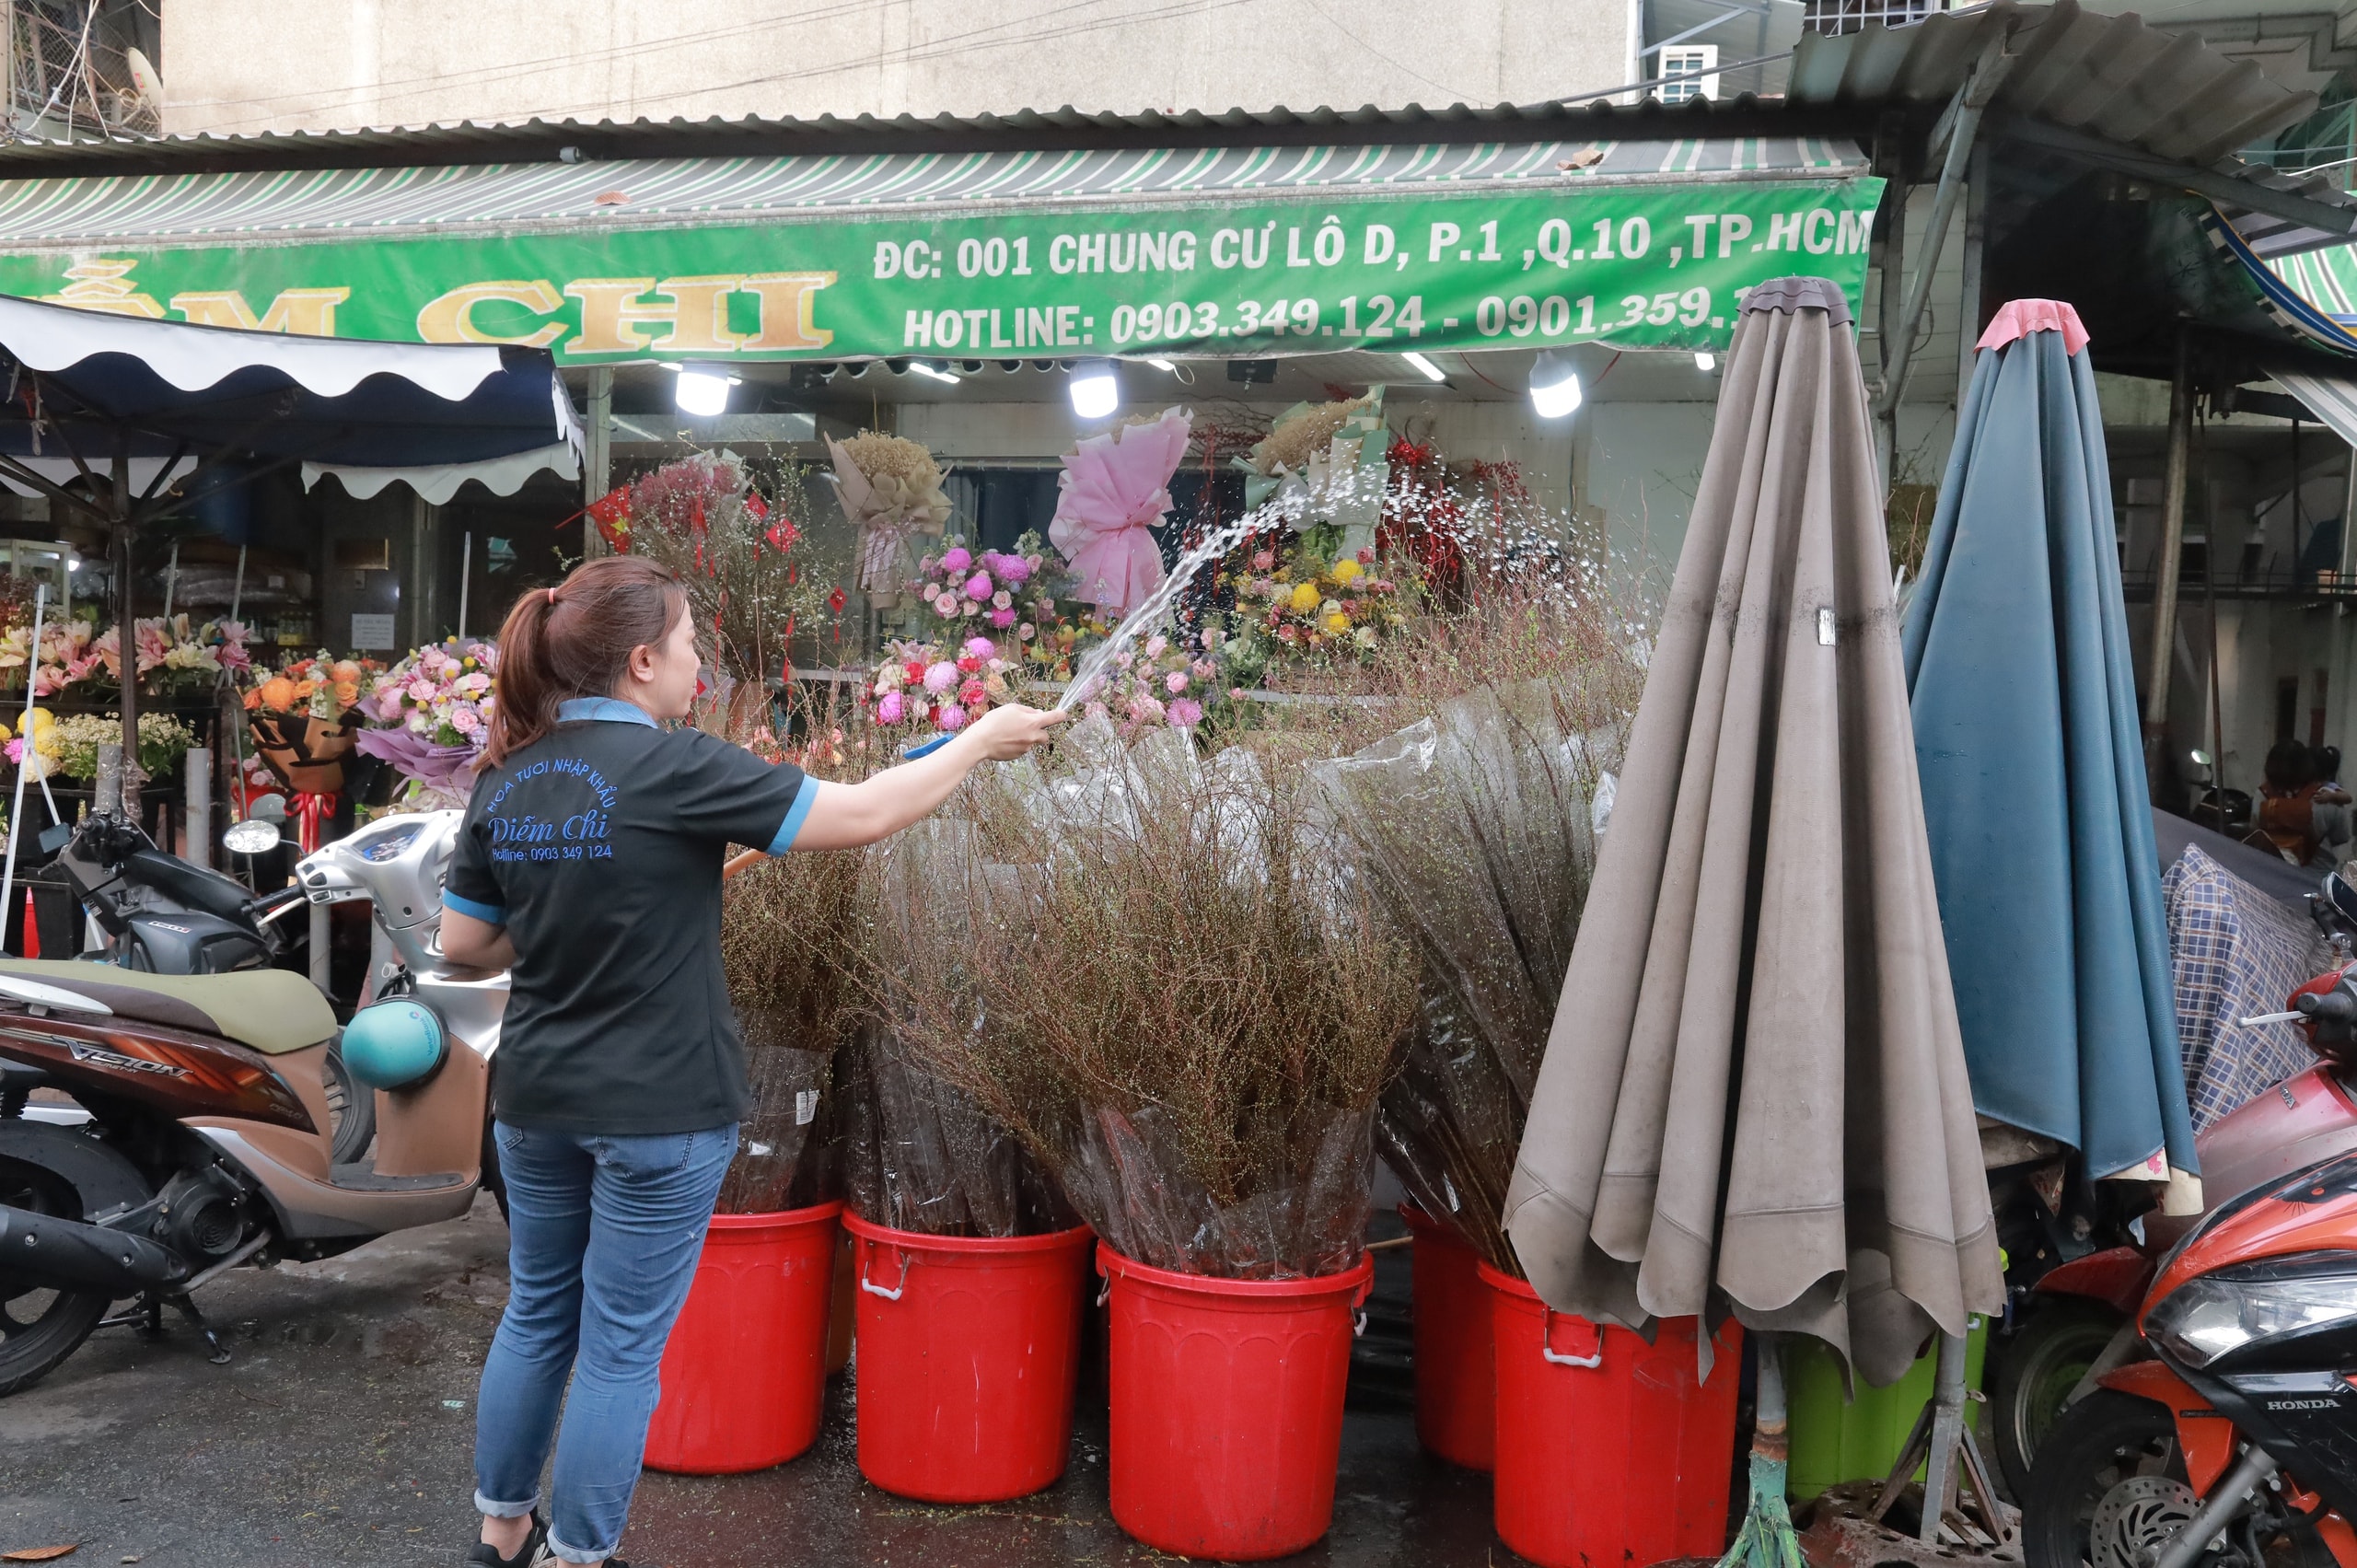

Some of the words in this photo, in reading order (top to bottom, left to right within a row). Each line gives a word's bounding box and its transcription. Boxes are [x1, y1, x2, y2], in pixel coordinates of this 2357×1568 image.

[874, 240, 942, 279] ĐC:
[957, 236, 1032, 277] 001
[1049, 230, 1197, 274] CHUNG
[1211, 220, 1276, 269] CƯ
[1286, 215, 1345, 267] LÔ
[1364, 224, 1410, 271] D,
[1428, 220, 1503, 263] P.1
[416, 271, 838, 354] CHI
[903, 305, 1095, 347] HOTLINE:
[1109, 294, 1426, 344] 0903.349.124
[487, 781, 515, 813] HOA
[552, 758, 590, 777] NHẬP
[586, 770, 618, 809] KHẨU
[488, 815, 558, 842] Diễm
[563, 809, 611, 841] Chi
[492, 848, 528, 862] Hotline:
[530, 847, 559, 861] 0903
[563, 845, 583, 860] 349
[587, 844, 612, 858] 124
[2267, 1399, 2340, 1411] HONDA
